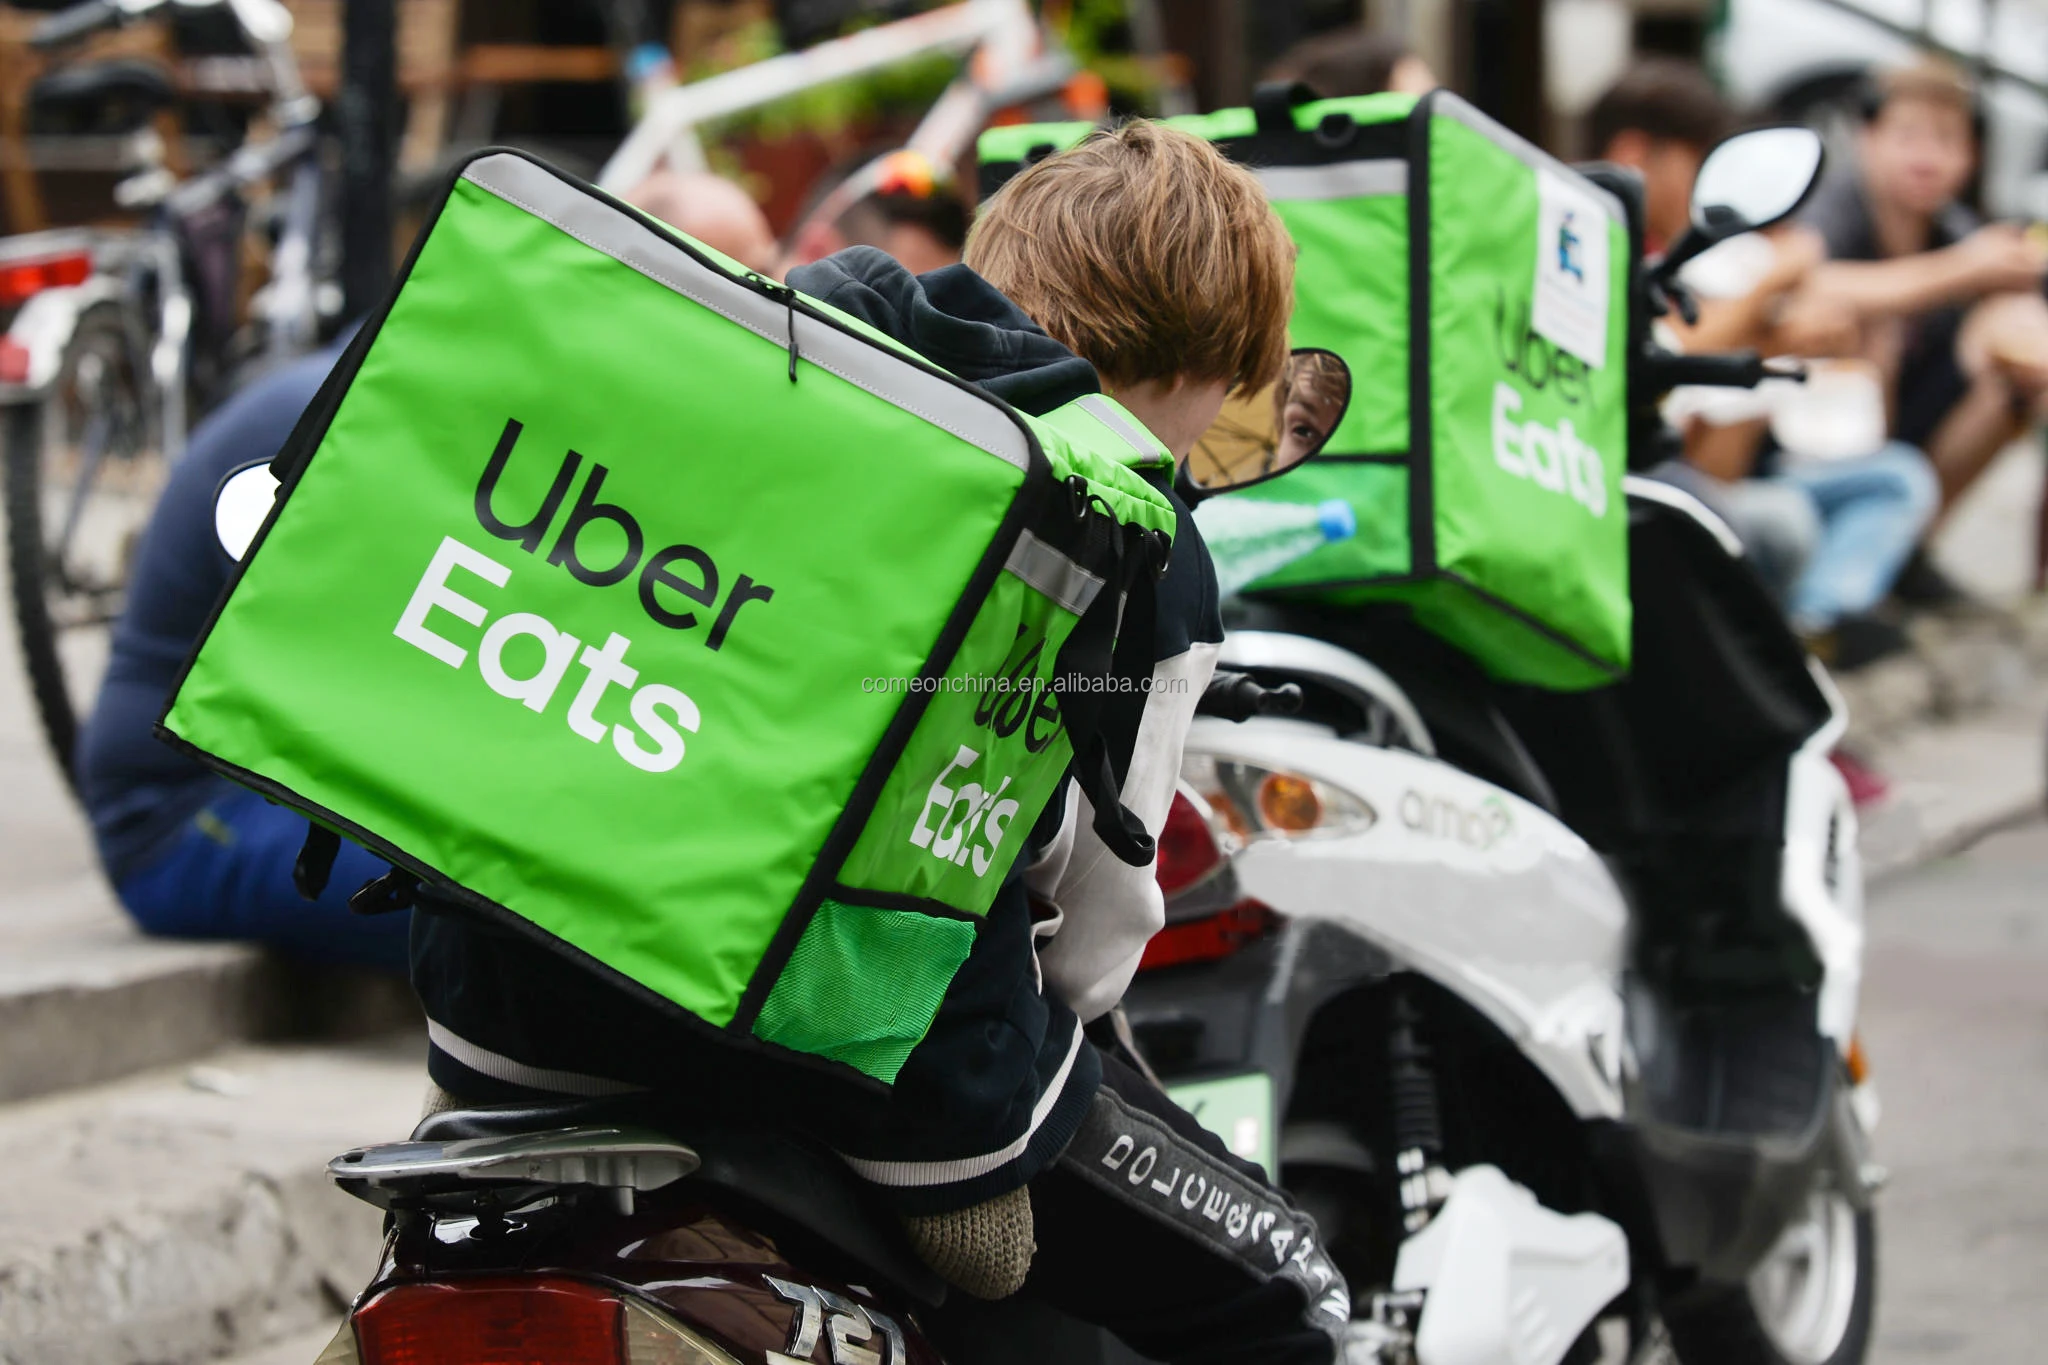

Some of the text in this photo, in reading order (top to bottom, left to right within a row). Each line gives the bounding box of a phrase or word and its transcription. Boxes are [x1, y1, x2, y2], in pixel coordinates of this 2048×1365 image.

[473, 417, 775, 653] Uber
[1491, 379, 1608, 519] Eats
[392, 535, 701, 773] Eats
